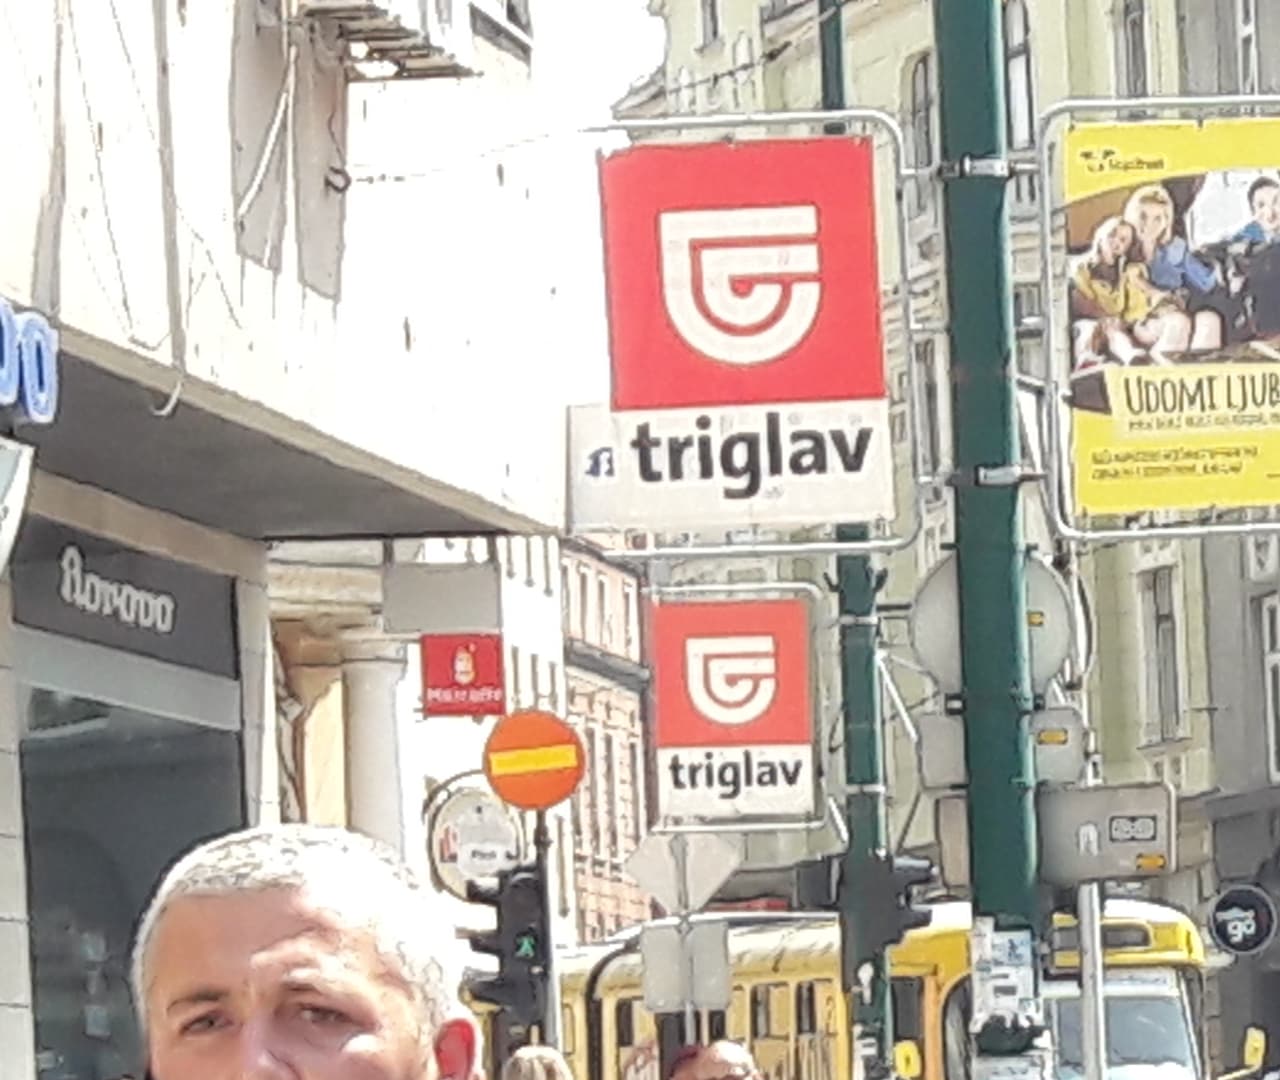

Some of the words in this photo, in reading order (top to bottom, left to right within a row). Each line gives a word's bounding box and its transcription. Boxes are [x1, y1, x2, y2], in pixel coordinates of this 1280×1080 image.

[1124, 374, 1217, 416] UDOMI
[630, 411, 874, 500] triglav
[669, 749, 803, 799] triglav
